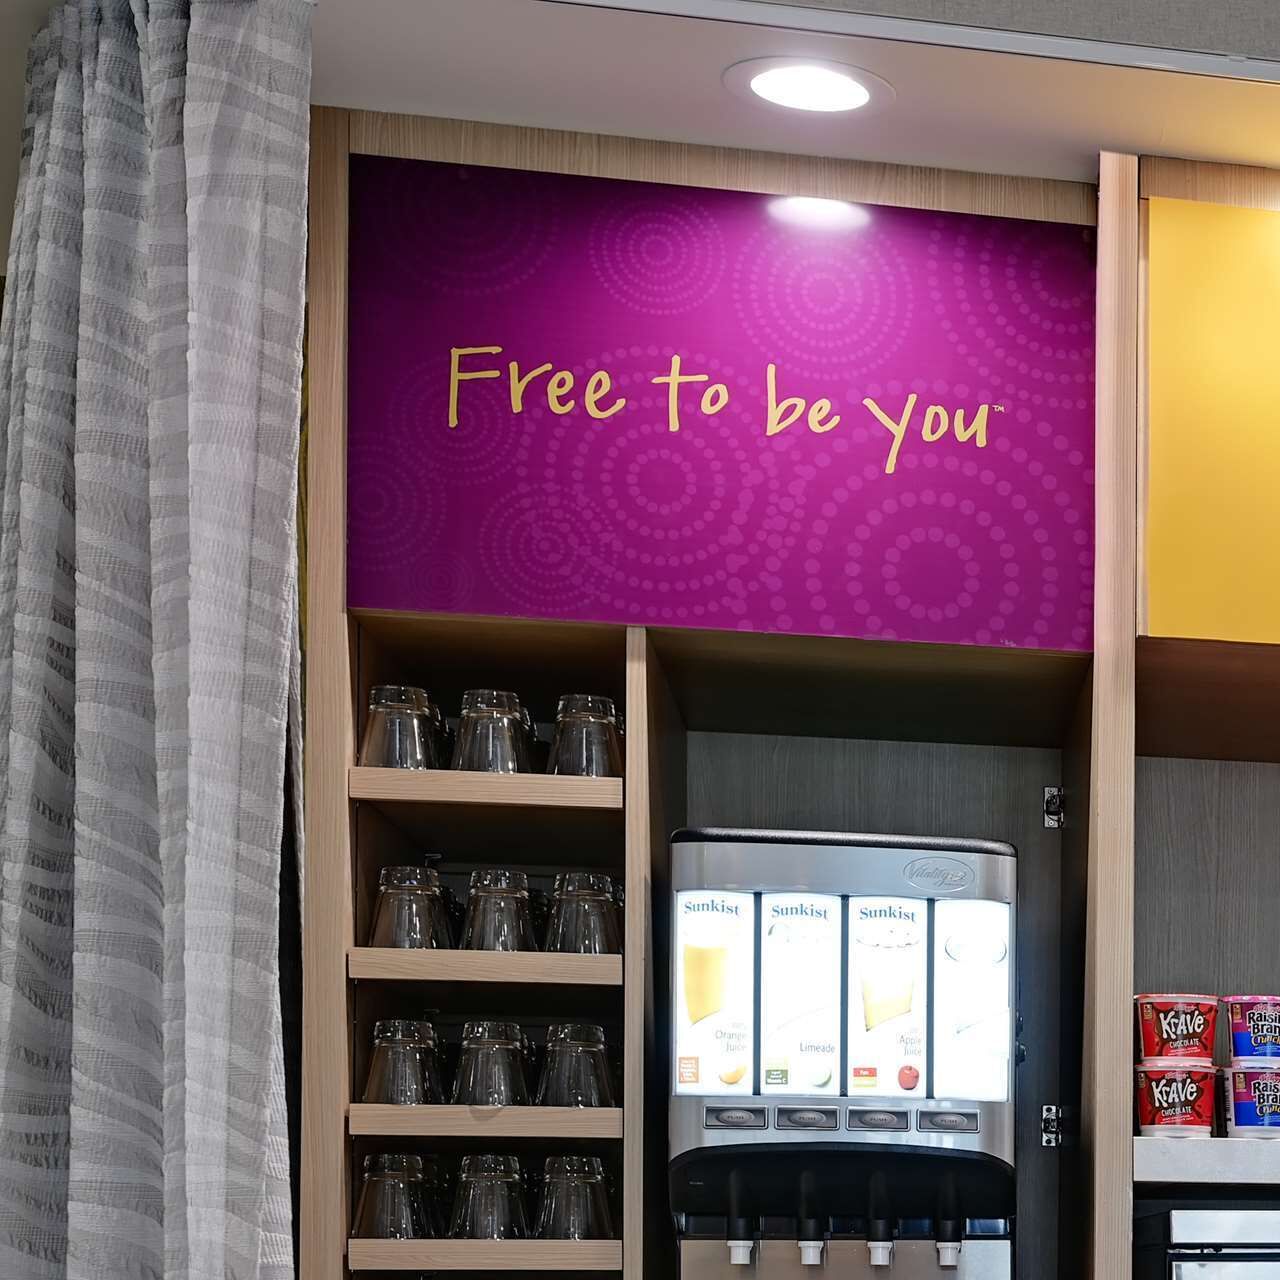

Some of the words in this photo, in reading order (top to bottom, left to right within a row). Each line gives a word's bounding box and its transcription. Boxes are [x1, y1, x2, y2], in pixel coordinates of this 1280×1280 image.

[449, 346, 626, 427] Free
[652, 354, 729, 431] to
[765, 364, 841, 436] be
[684, 899, 740, 916] Sunkist
[771, 903, 829, 920] Sunkist
[859, 905, 917, 923] Sunkist
[800, 1041, 835, 1054] Limeade
[1169, 1038, 1200, 1049] CHOCOLATE
[1161, 1106, 1193, 1117] CHOCOLATE
